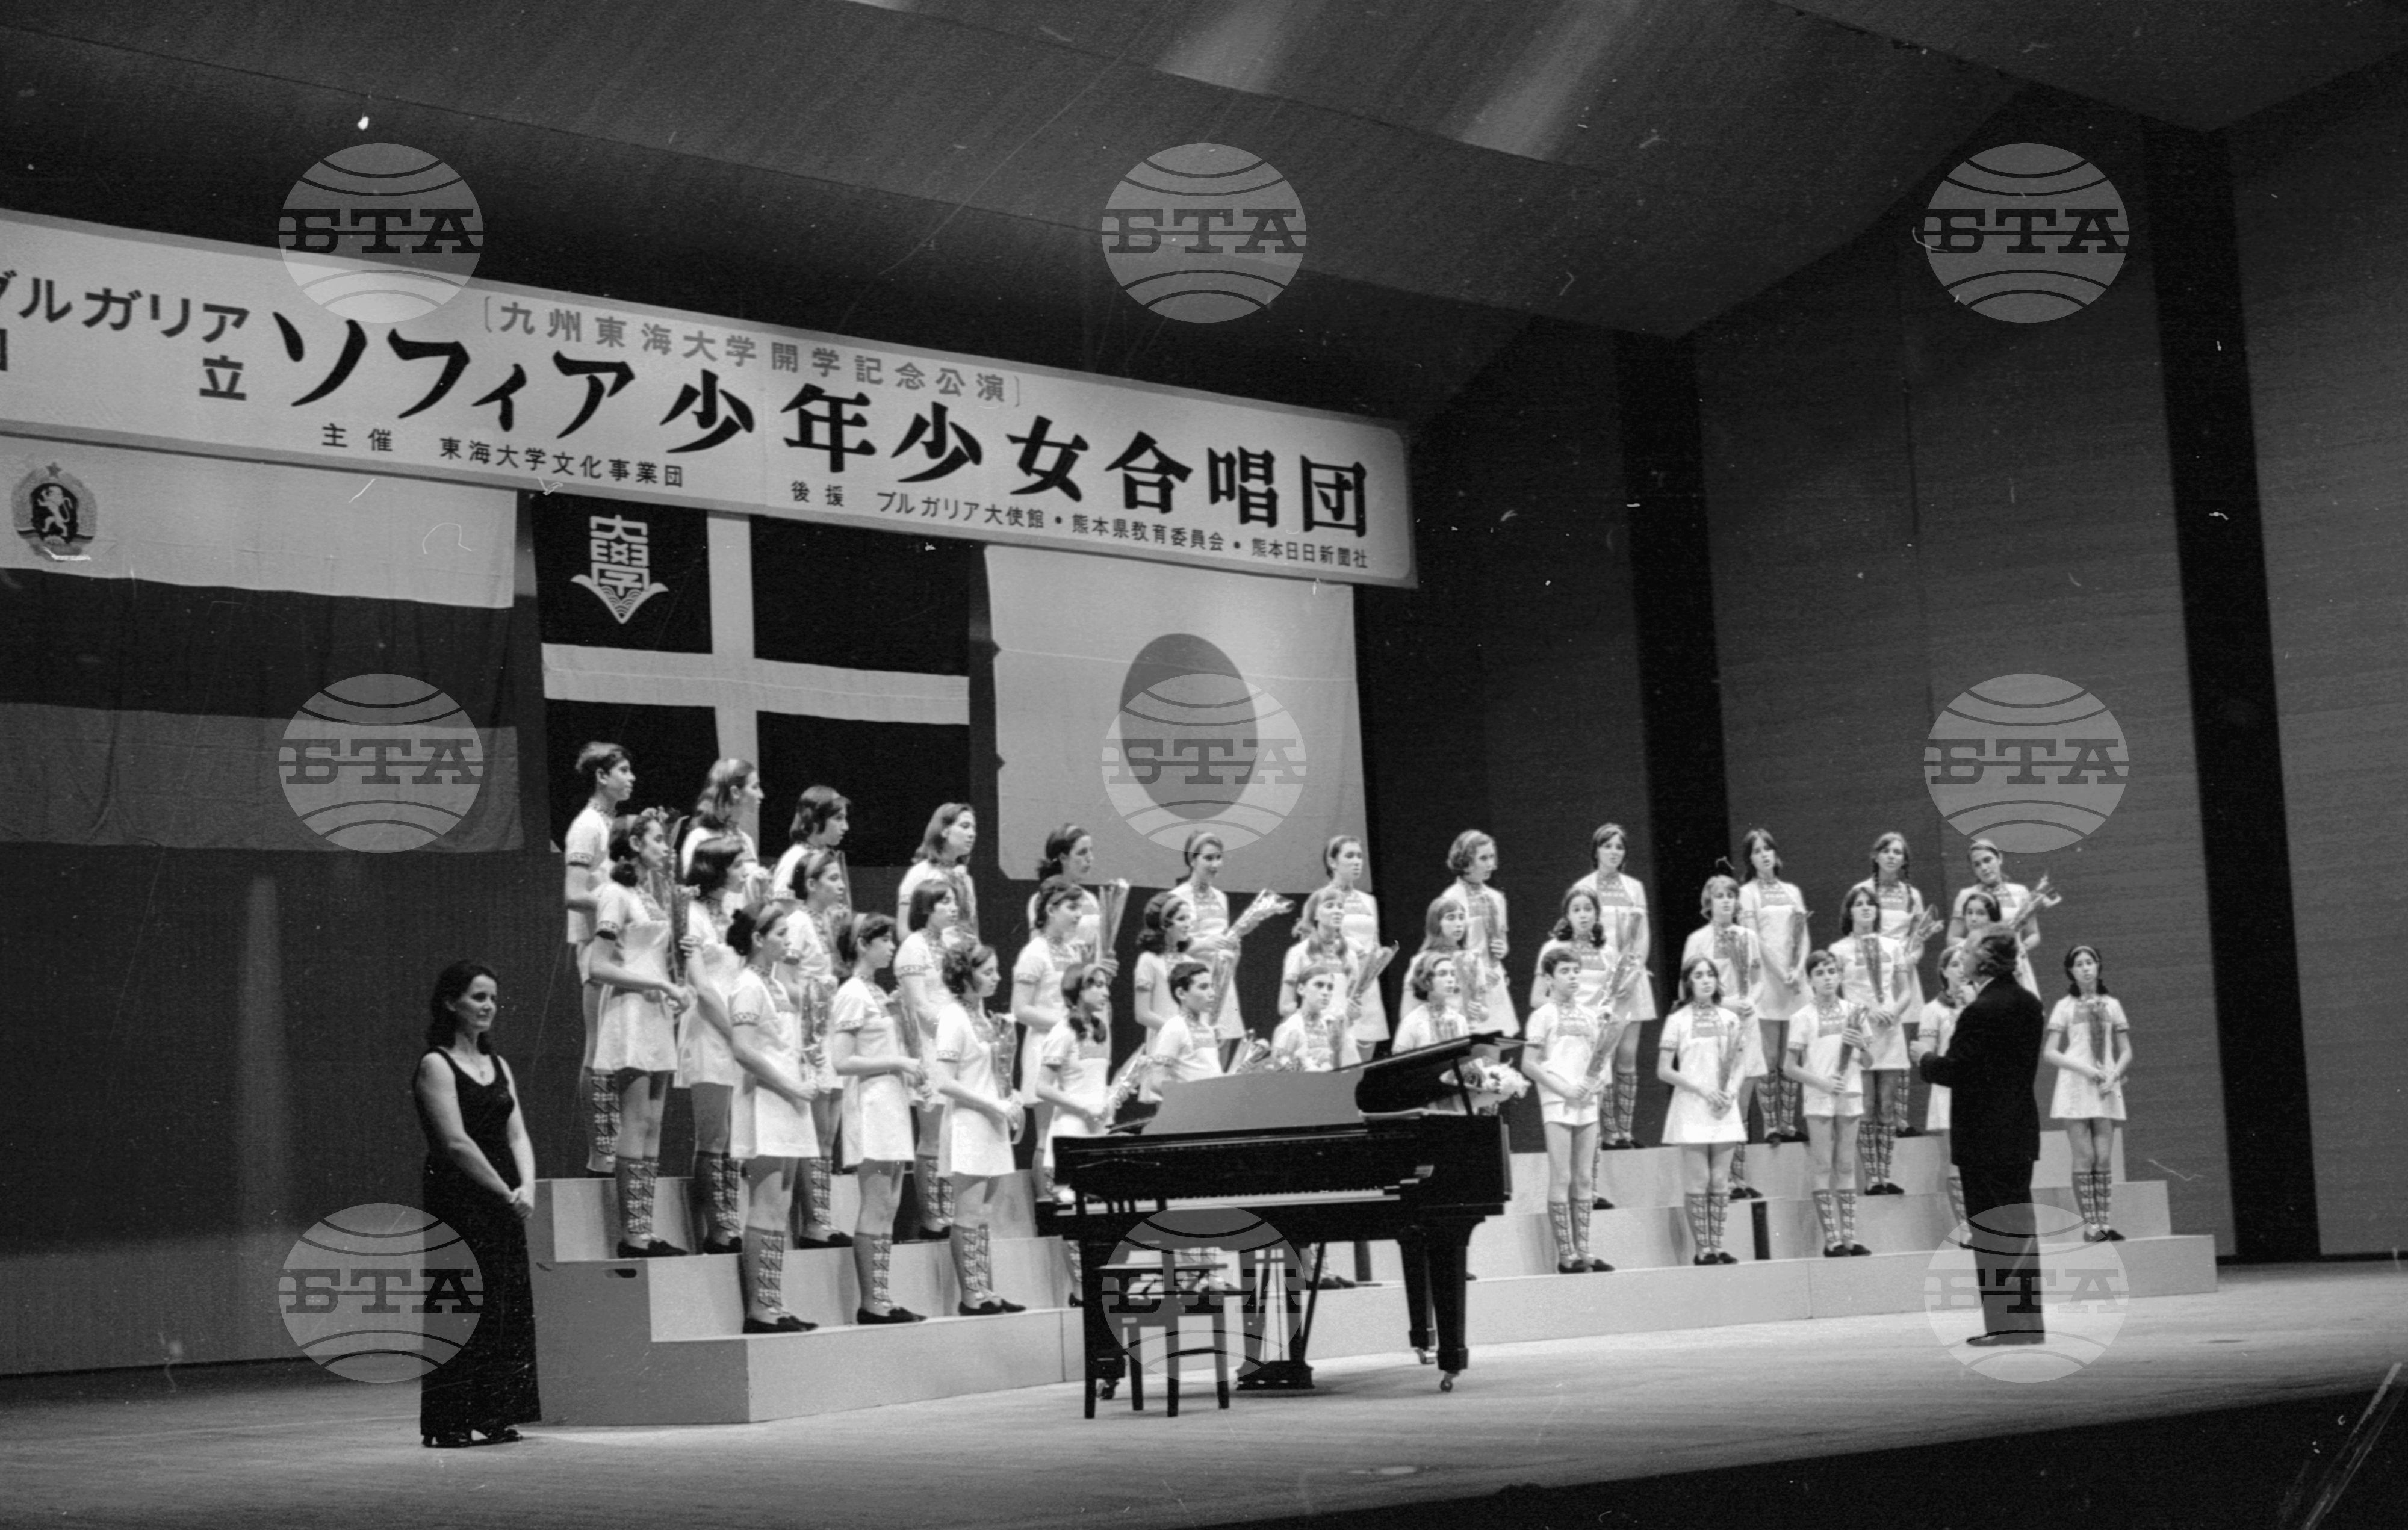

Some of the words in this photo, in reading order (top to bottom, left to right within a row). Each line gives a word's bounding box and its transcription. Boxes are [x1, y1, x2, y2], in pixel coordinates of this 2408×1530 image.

[272, 311, 1367, 537] ソフィア少年少女合唱団
[439, 436, 684, 488] 東海大学文化事業団
